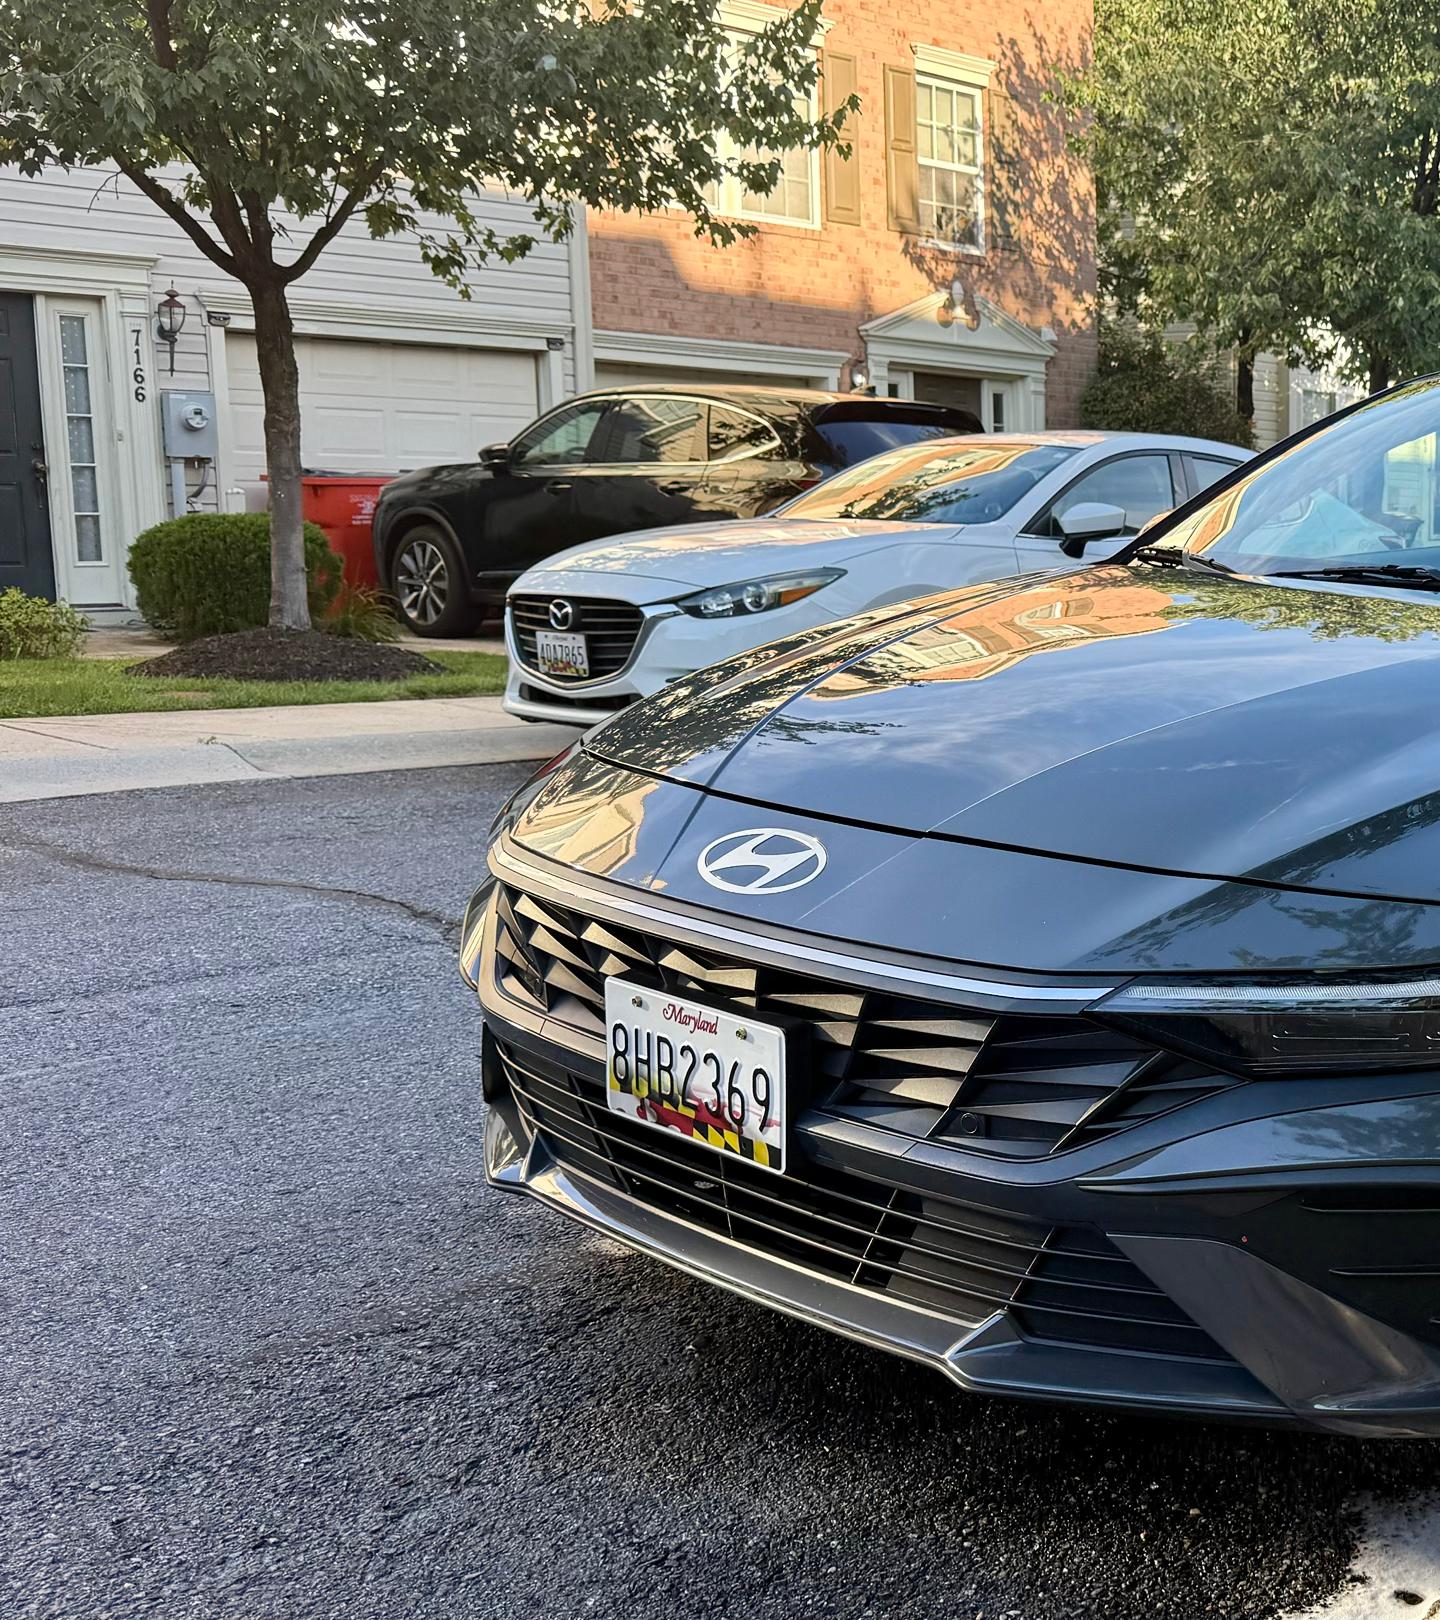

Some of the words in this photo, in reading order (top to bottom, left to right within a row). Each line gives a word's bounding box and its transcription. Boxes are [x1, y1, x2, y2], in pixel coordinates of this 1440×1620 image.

[131, 329, 145, 402] 7166
[662, 1003, 719, 1035] Maryland
[612, 1022, 770, 1133] 8HB2369
